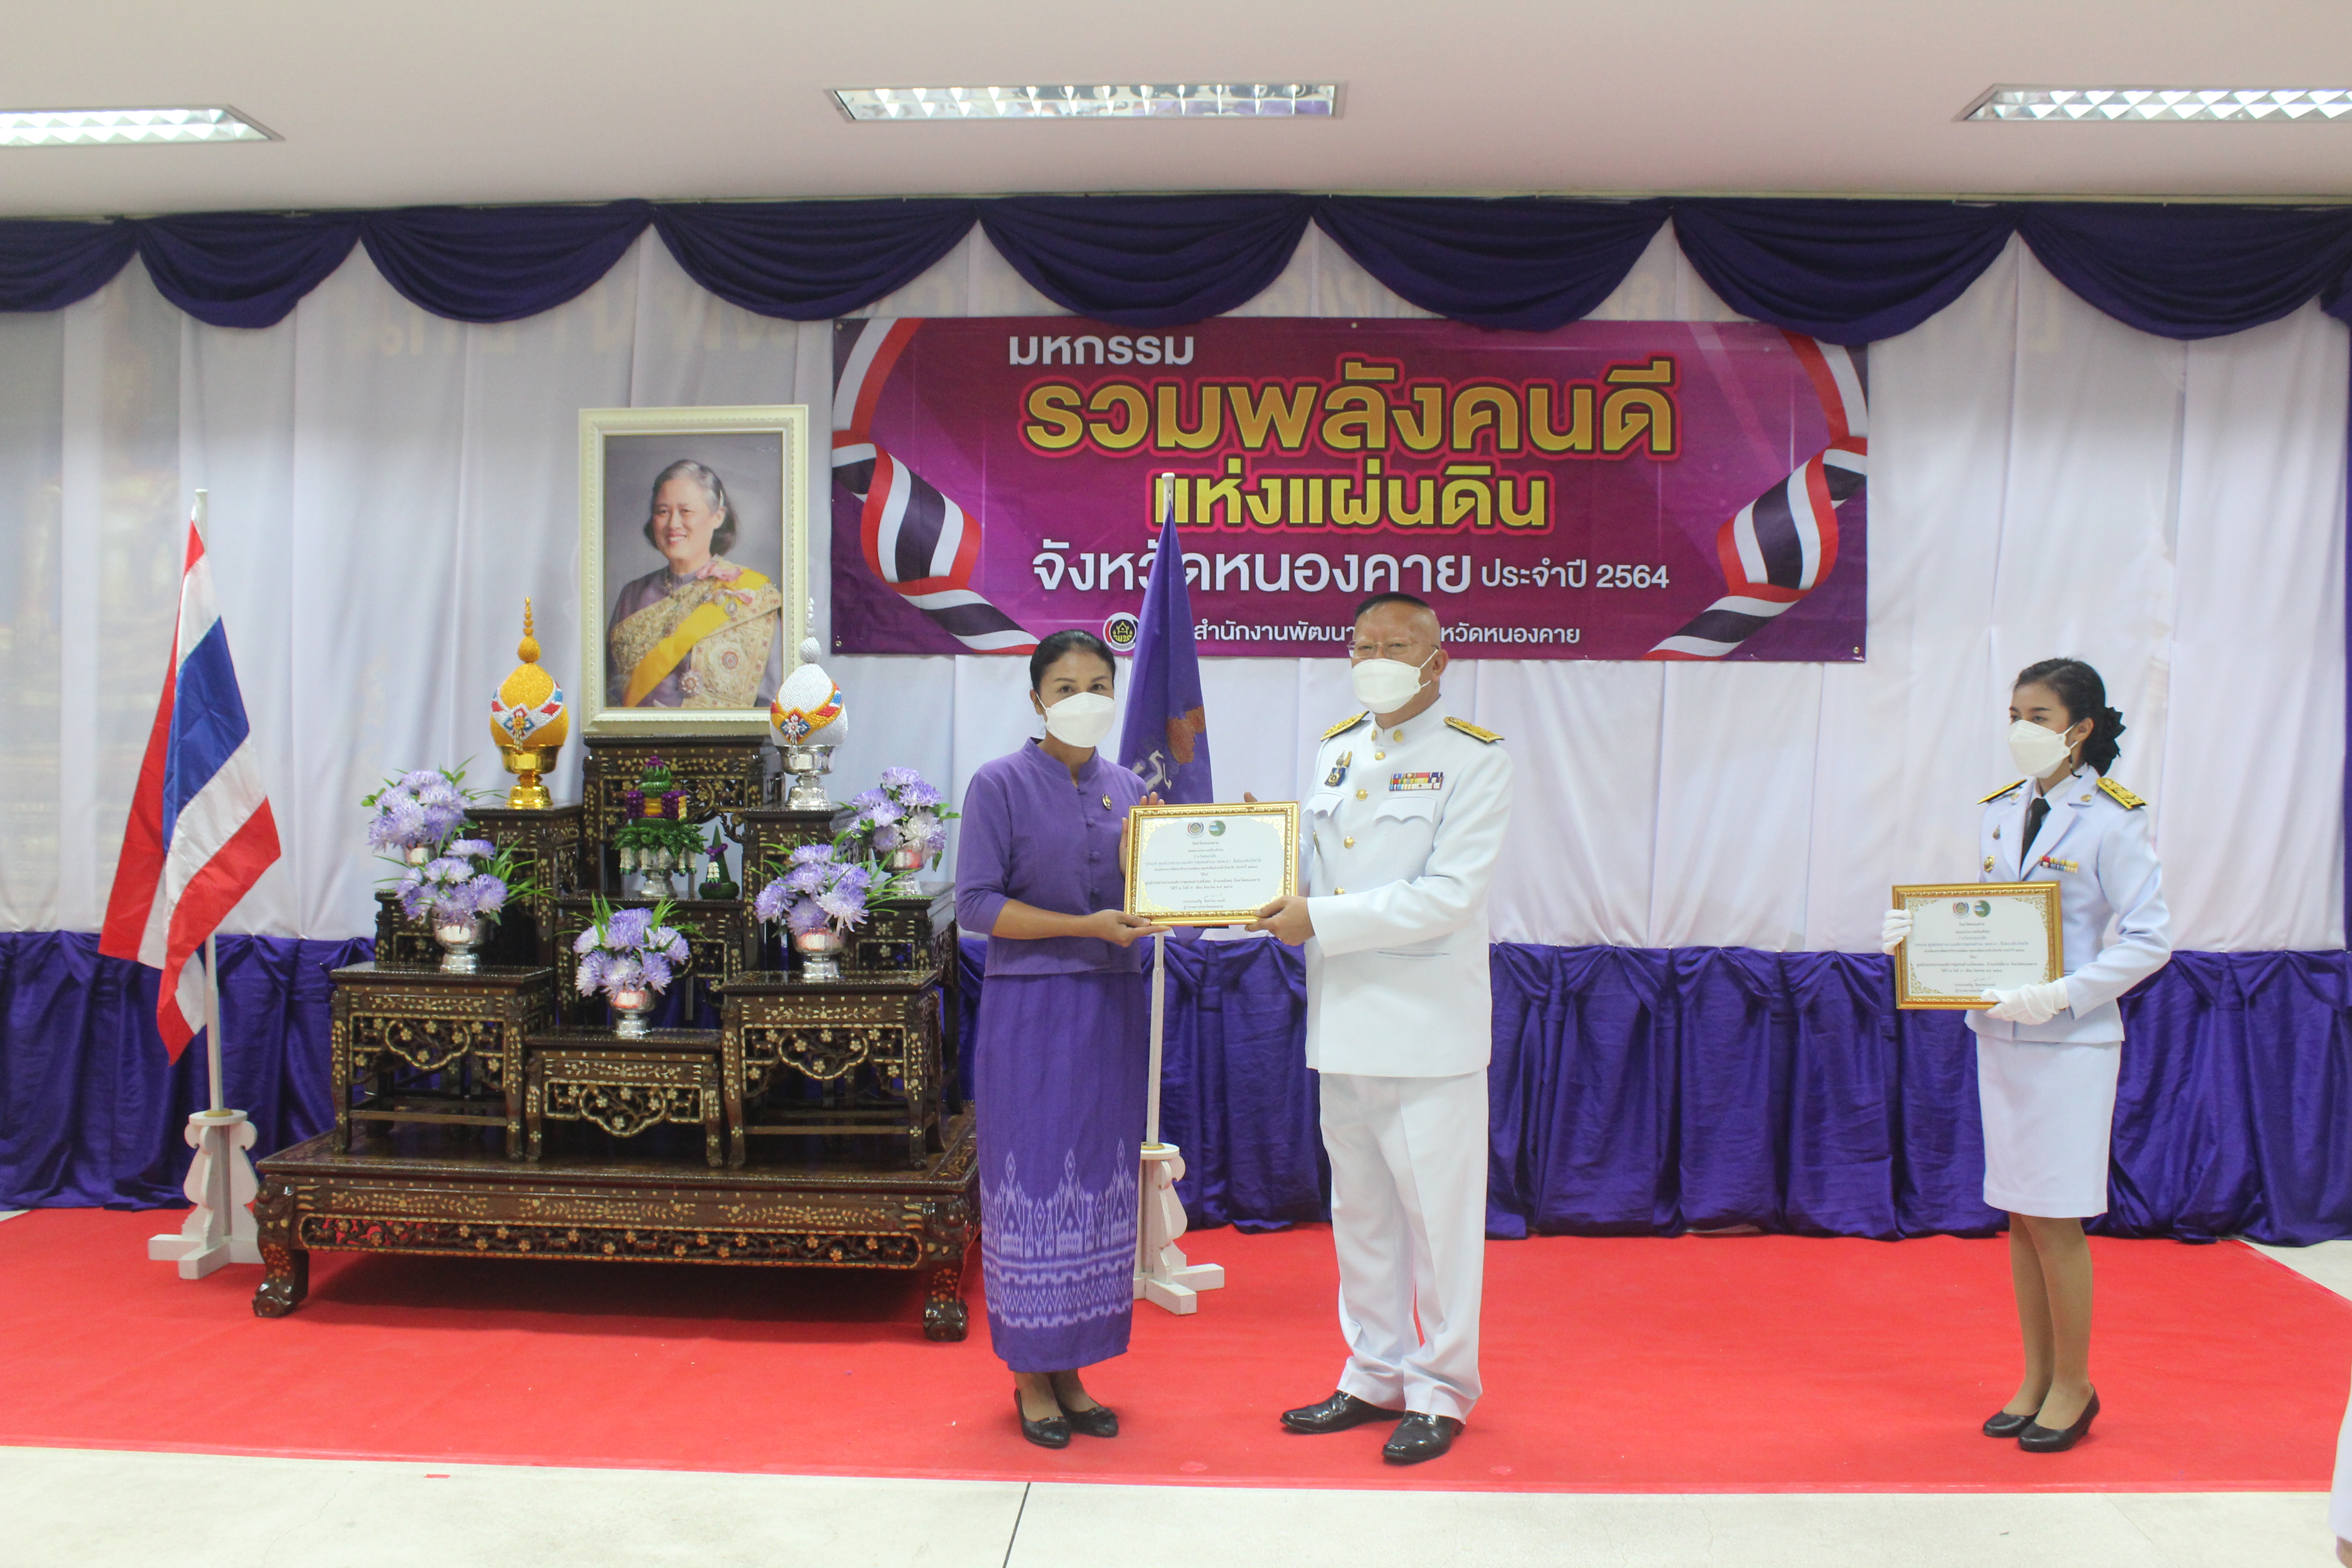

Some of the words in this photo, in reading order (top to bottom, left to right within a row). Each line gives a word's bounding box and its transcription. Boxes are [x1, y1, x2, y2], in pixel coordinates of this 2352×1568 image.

[1009, 335, 1194, 365] มหกรรม
[1024, 359, 1672, 451] รวมพลังคนดี
[1155, 458, 1545, 526] แห่งแผ่นดิน
[1481, 557, 1587, 588] ประจำปี
[1596, 564, 1670, 588] 2564
